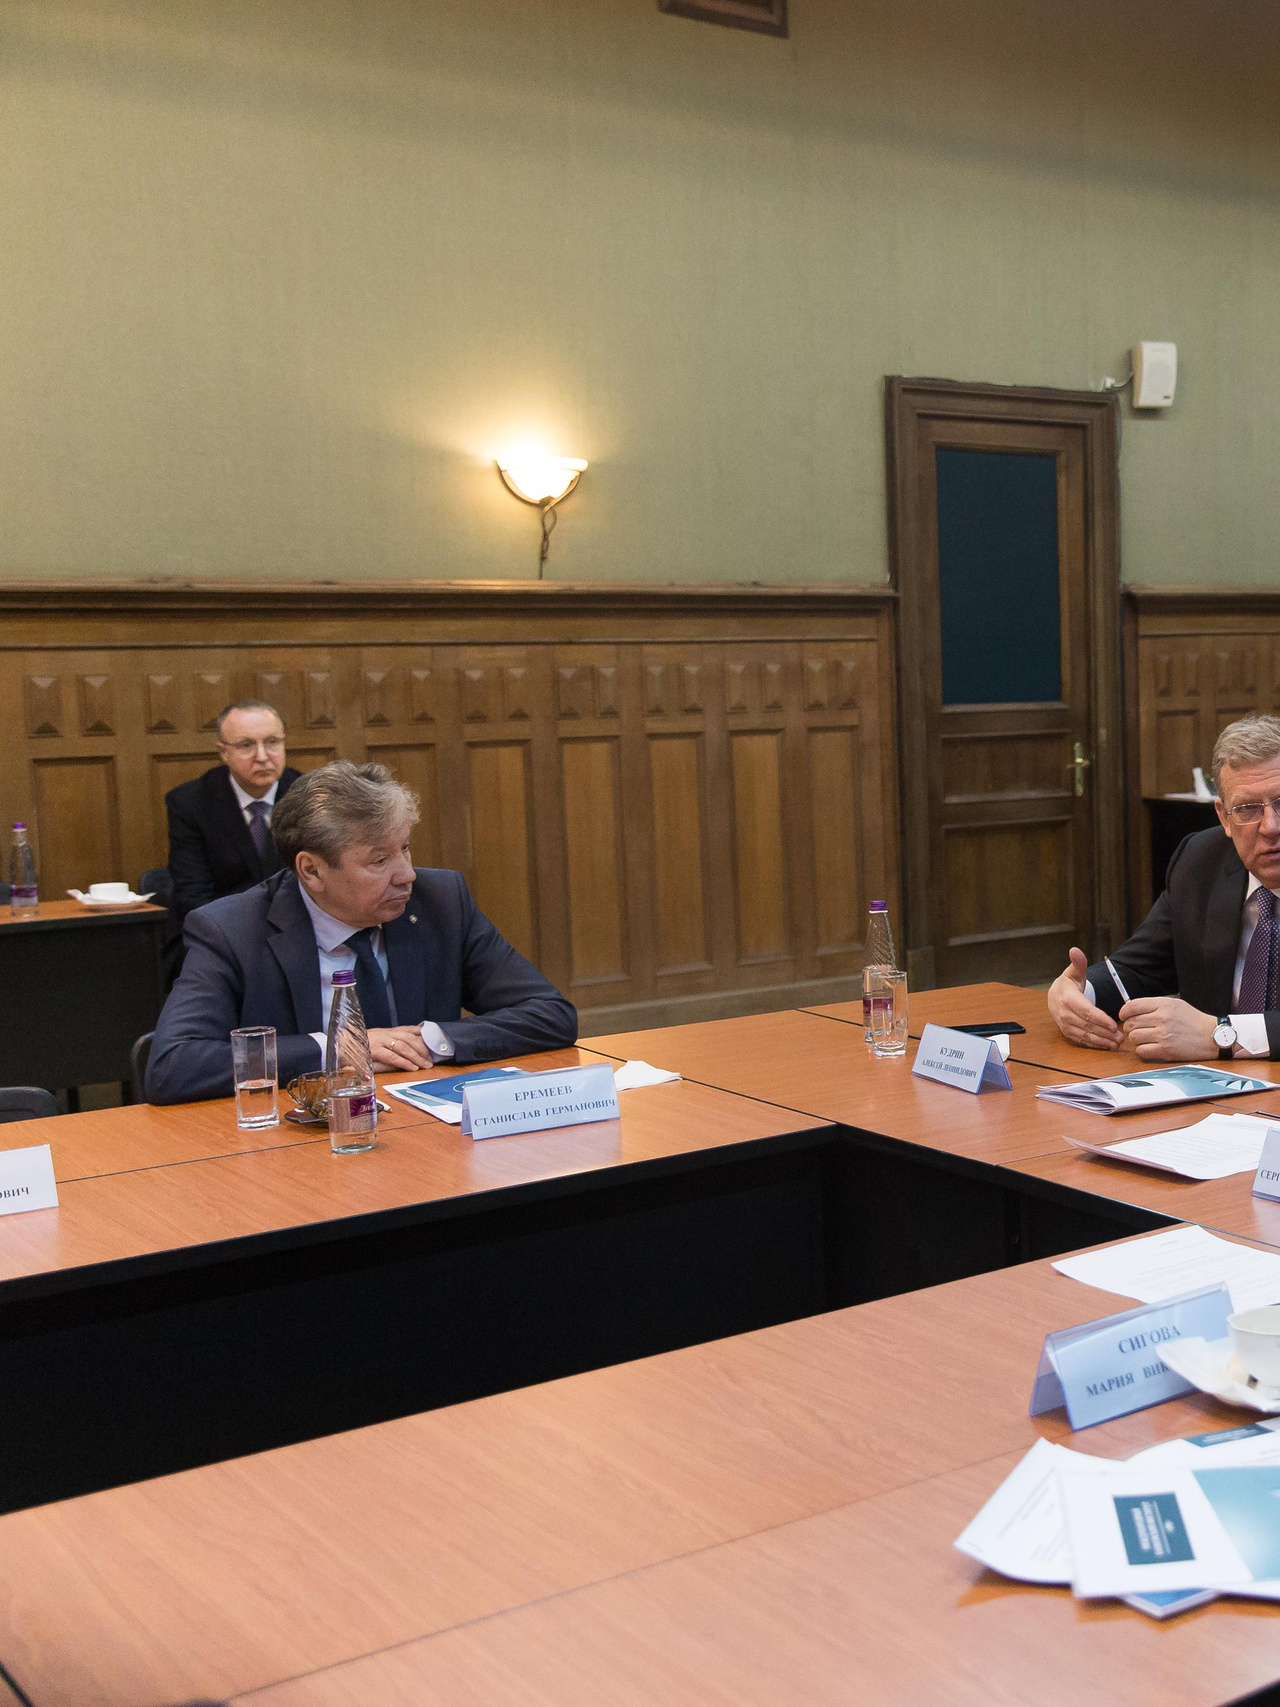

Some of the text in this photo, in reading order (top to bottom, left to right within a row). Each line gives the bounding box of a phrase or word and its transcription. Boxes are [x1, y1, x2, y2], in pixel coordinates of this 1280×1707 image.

[514, 1085, 573, 1102] ЕРЕМЕЕВ
[474, 1099, 615, 1127] СТАНИСЛАВ ГЕРМАНОВИЧ
[1118, 1325, 1181, 1354] СИГОВА
[1086, 1372, 1135, 1398] МАРИЯ
